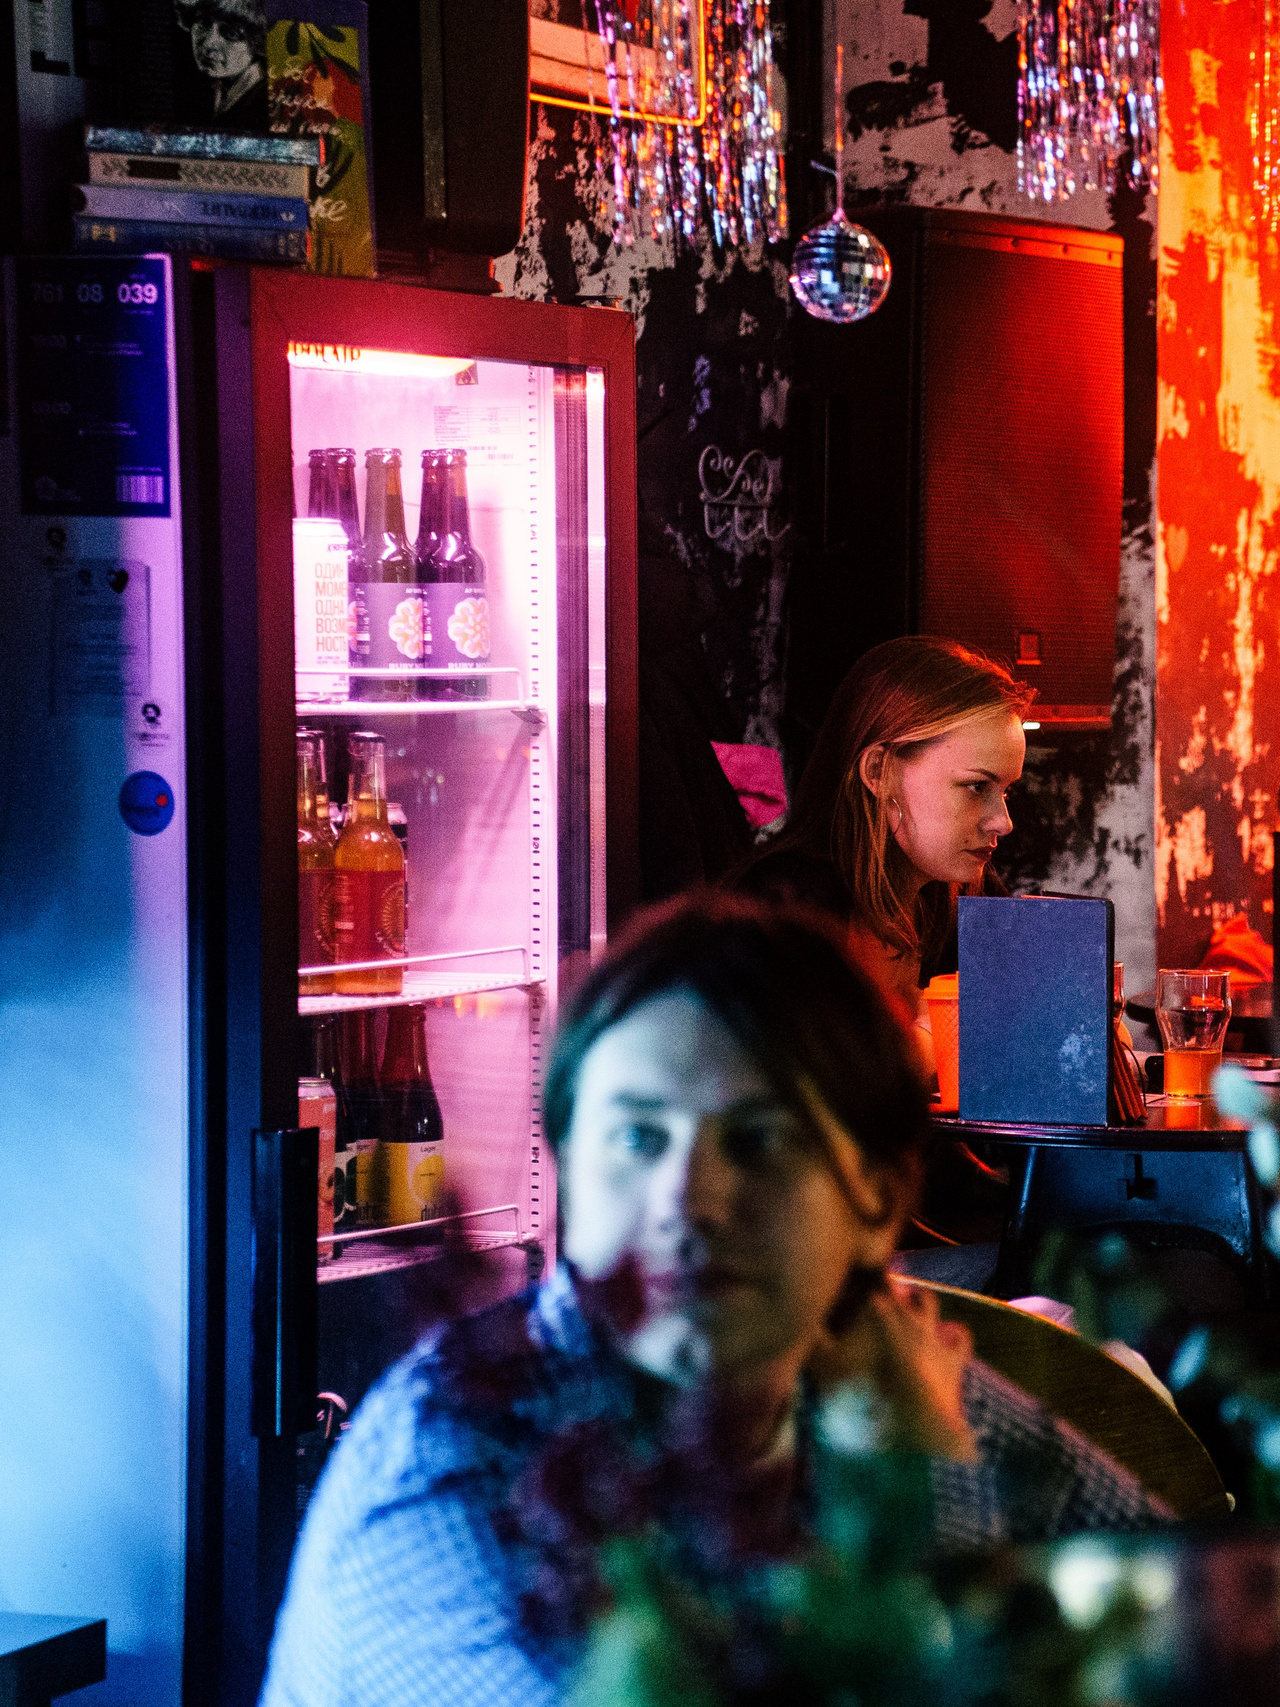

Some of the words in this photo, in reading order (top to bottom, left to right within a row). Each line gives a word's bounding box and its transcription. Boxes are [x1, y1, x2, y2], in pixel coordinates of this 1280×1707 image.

[77, 283, 104, 302] 08
[116, 283, 158, 304] 039
[420, 1146, 437, 1154] Lager
